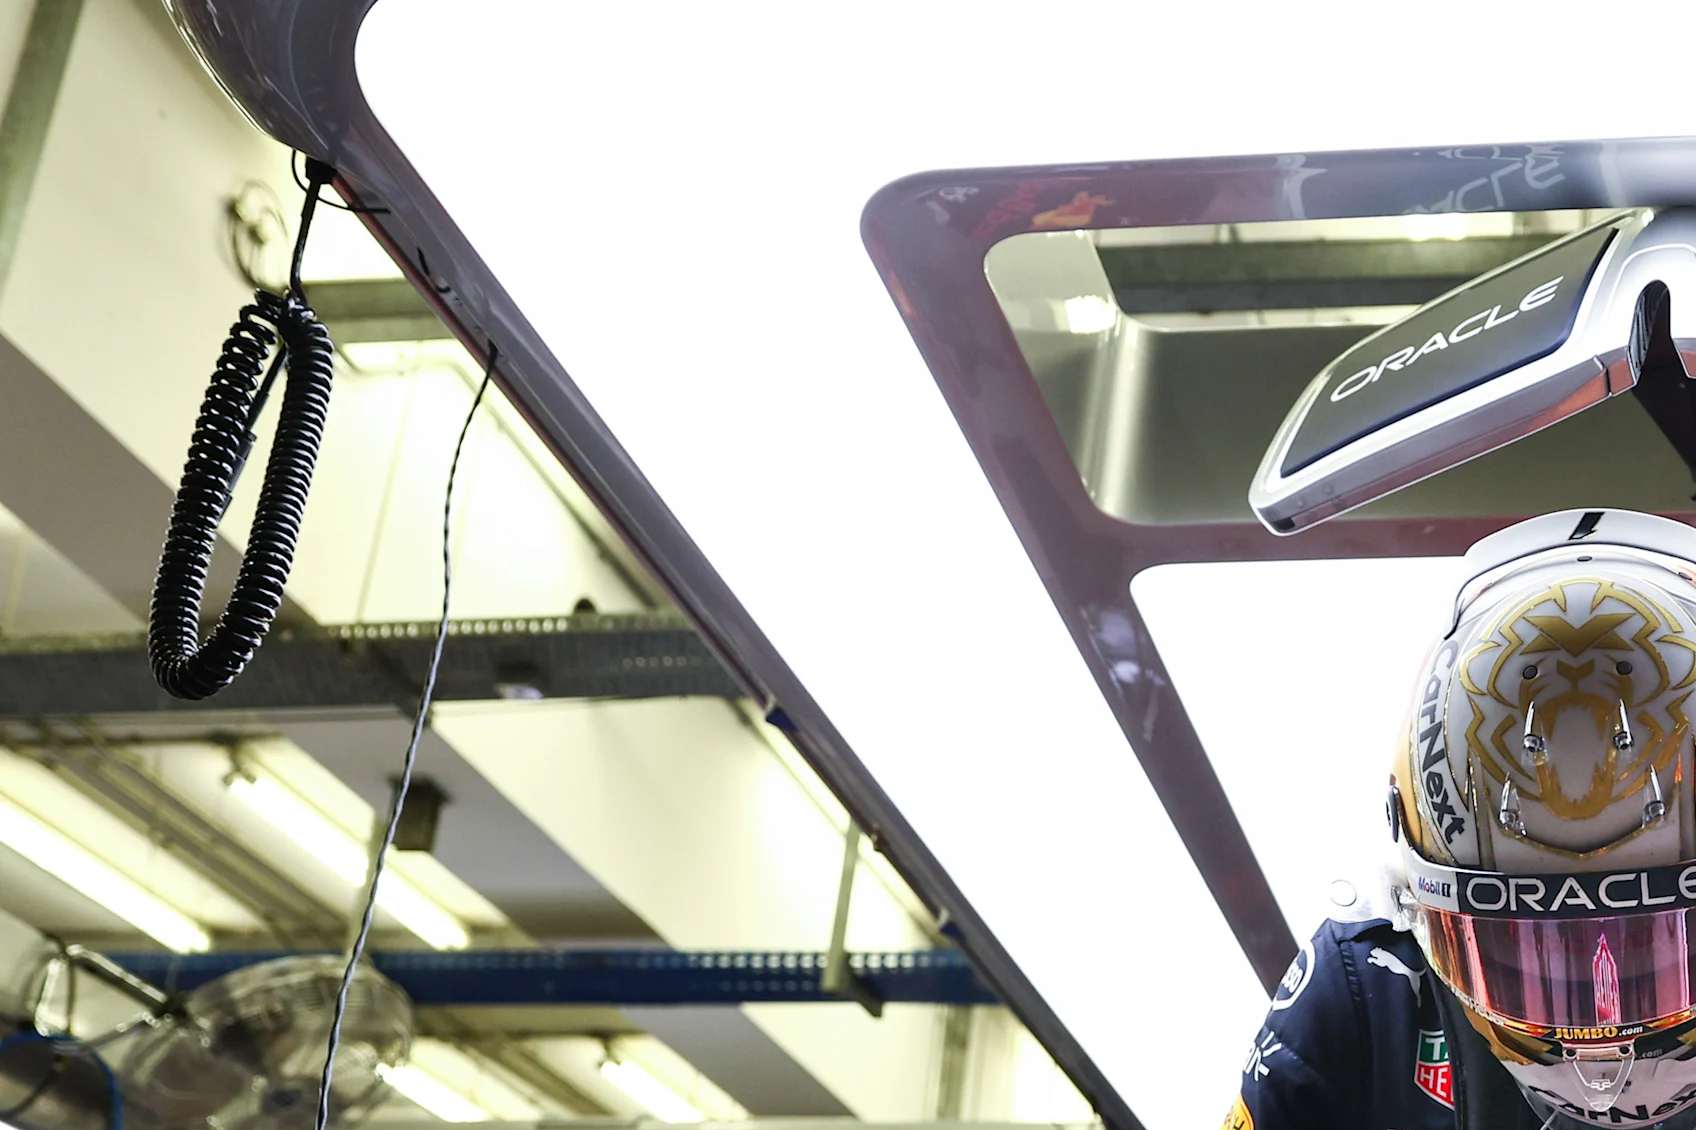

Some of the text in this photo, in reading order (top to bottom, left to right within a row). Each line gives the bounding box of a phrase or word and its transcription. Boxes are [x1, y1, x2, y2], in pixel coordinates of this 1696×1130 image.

[1331, 276, 1564, 402] ORACLE
[1420, 640, 1466, 845] CarNext
[1418, 876, 1441, 897] Mobil
